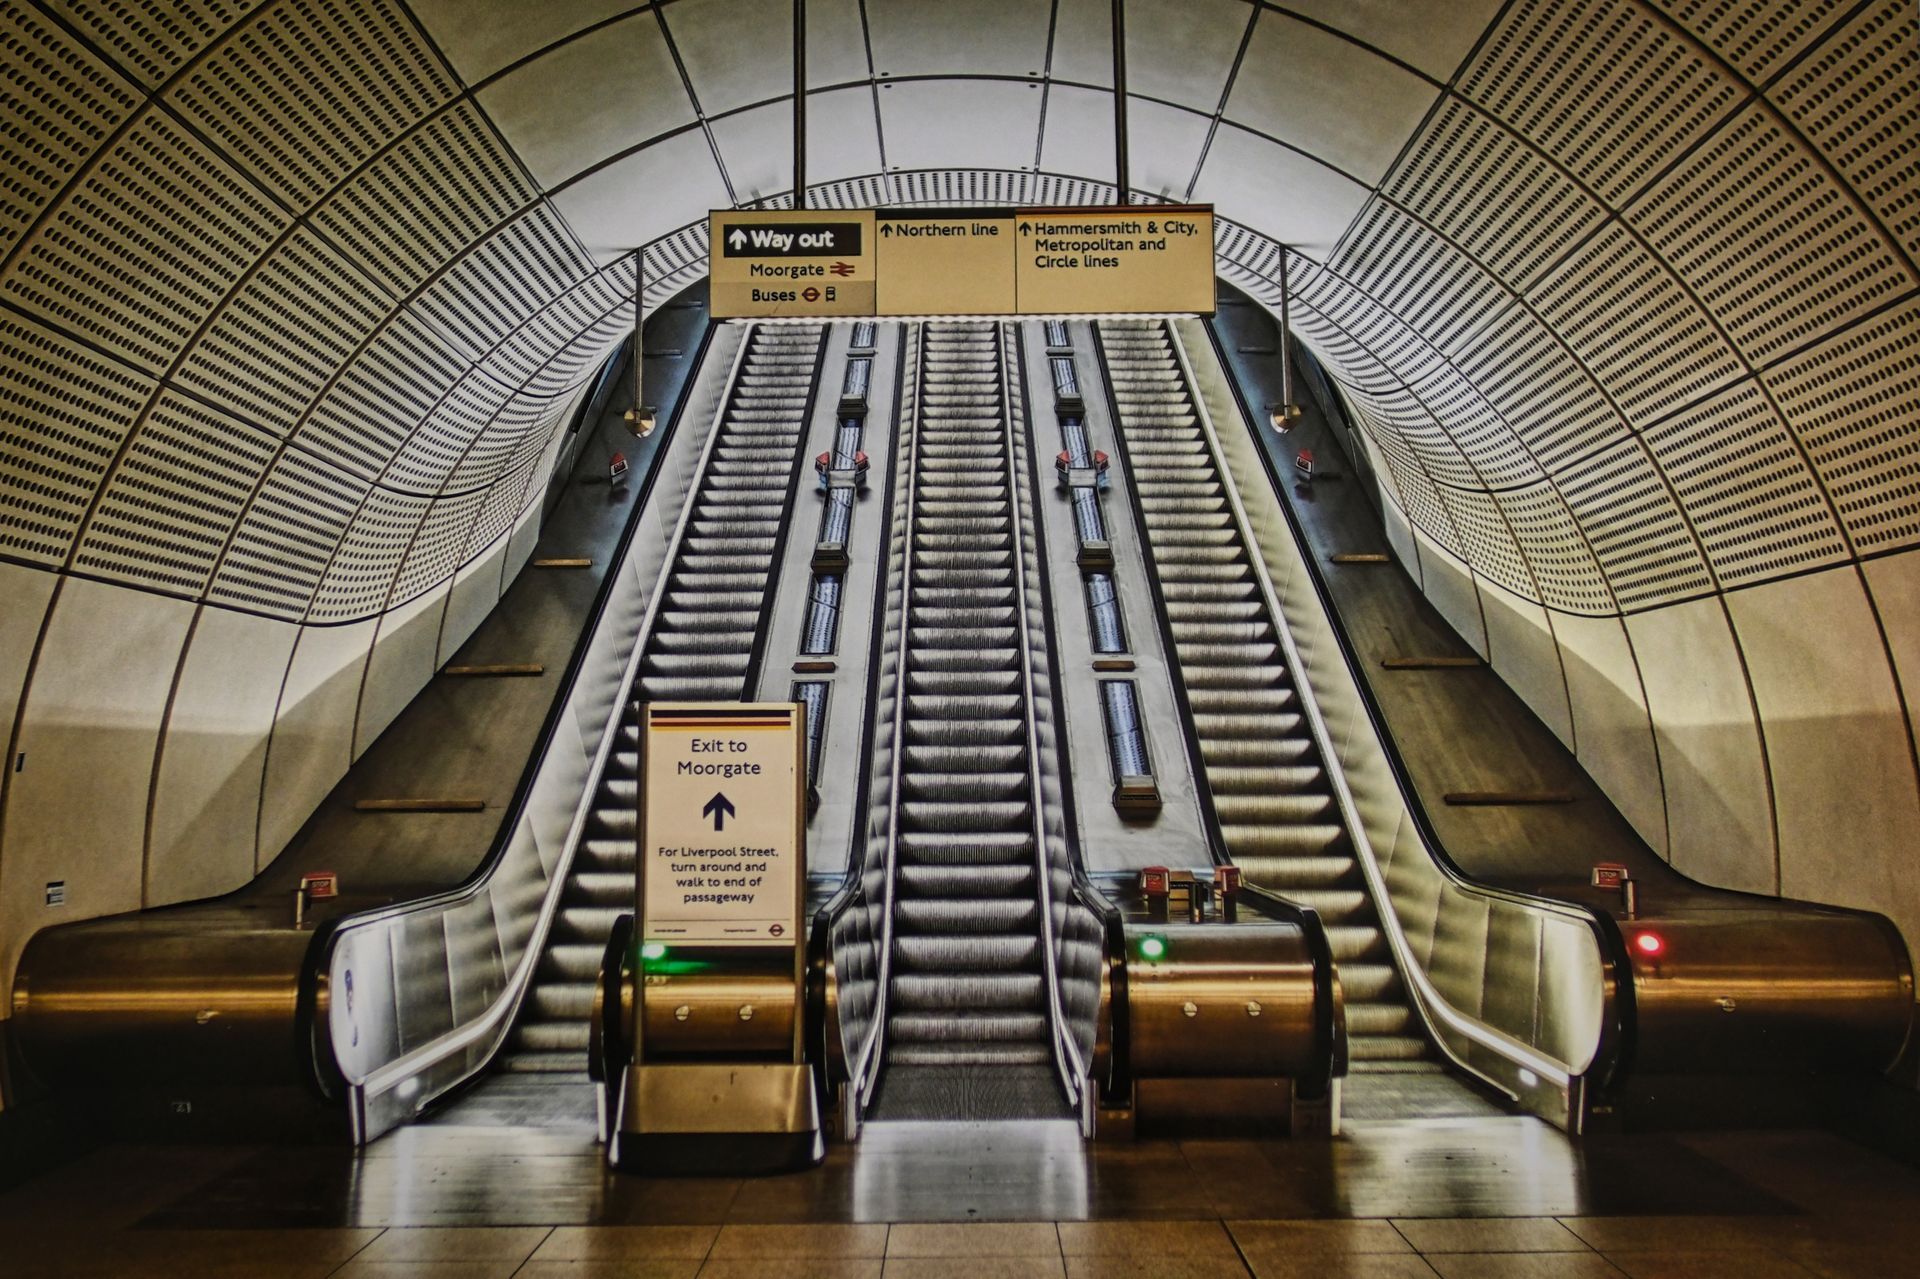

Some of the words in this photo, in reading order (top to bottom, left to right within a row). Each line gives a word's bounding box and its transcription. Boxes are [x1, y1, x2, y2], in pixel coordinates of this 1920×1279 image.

[896, 223, 966, 237] Northern
[971, 222, 999, 236] line
[1035, 221, 1142, 235] Hammersmith
[1147, 221, 1159, 234] &
[1164, 221, 1198, 237] City,
[750, 229, 794, 252] Way
[798, 230, 834, 248] out
[1035, 238, 1134, 253] Metropolitan
[1139, 237, 1166, 251] and
[1035, 255, 1079, 268] Circle
[1084, 254, 1119, 268] lines
[750, 263, 825, 279] Moorgate
[752, 288, 796, 302] Buses
[691, 738, 724, 753] Exit
[728, 740, 748, 753] to
[678, 761, 761, 778] Moorgate
[659, 847, 678, 857] For
[681, 847, 737, 859] Liverpool
[671, 862, 696, 872] turn
[700, 862, 741, 872] around
[745, 862, 766, 872] and
[676, 877, 705, 887] walk
[708, 878, 720, 887] to
[723, 877, 745, 887] end
[749, 877, 762, 887] of
[684, 893, 754, 904] passageway
